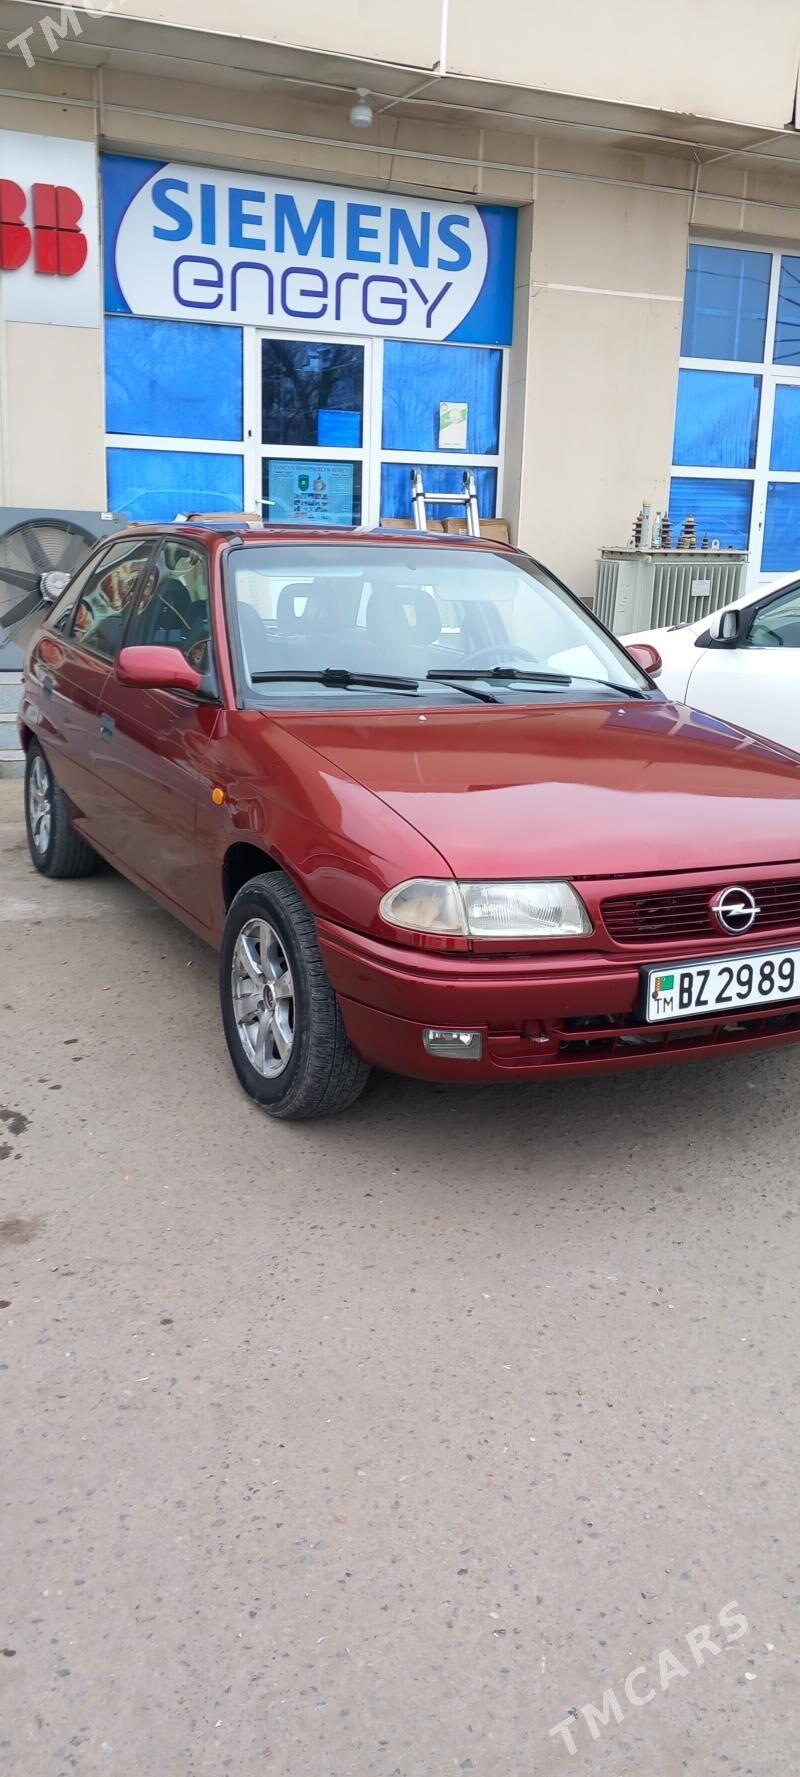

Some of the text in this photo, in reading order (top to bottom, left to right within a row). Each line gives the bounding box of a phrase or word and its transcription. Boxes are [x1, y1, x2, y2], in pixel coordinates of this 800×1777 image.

[151, 177, 472, 272] SIEMENS
[715, 957, 795, 1004] 2989
[654, 997, 674, 1014] TM
